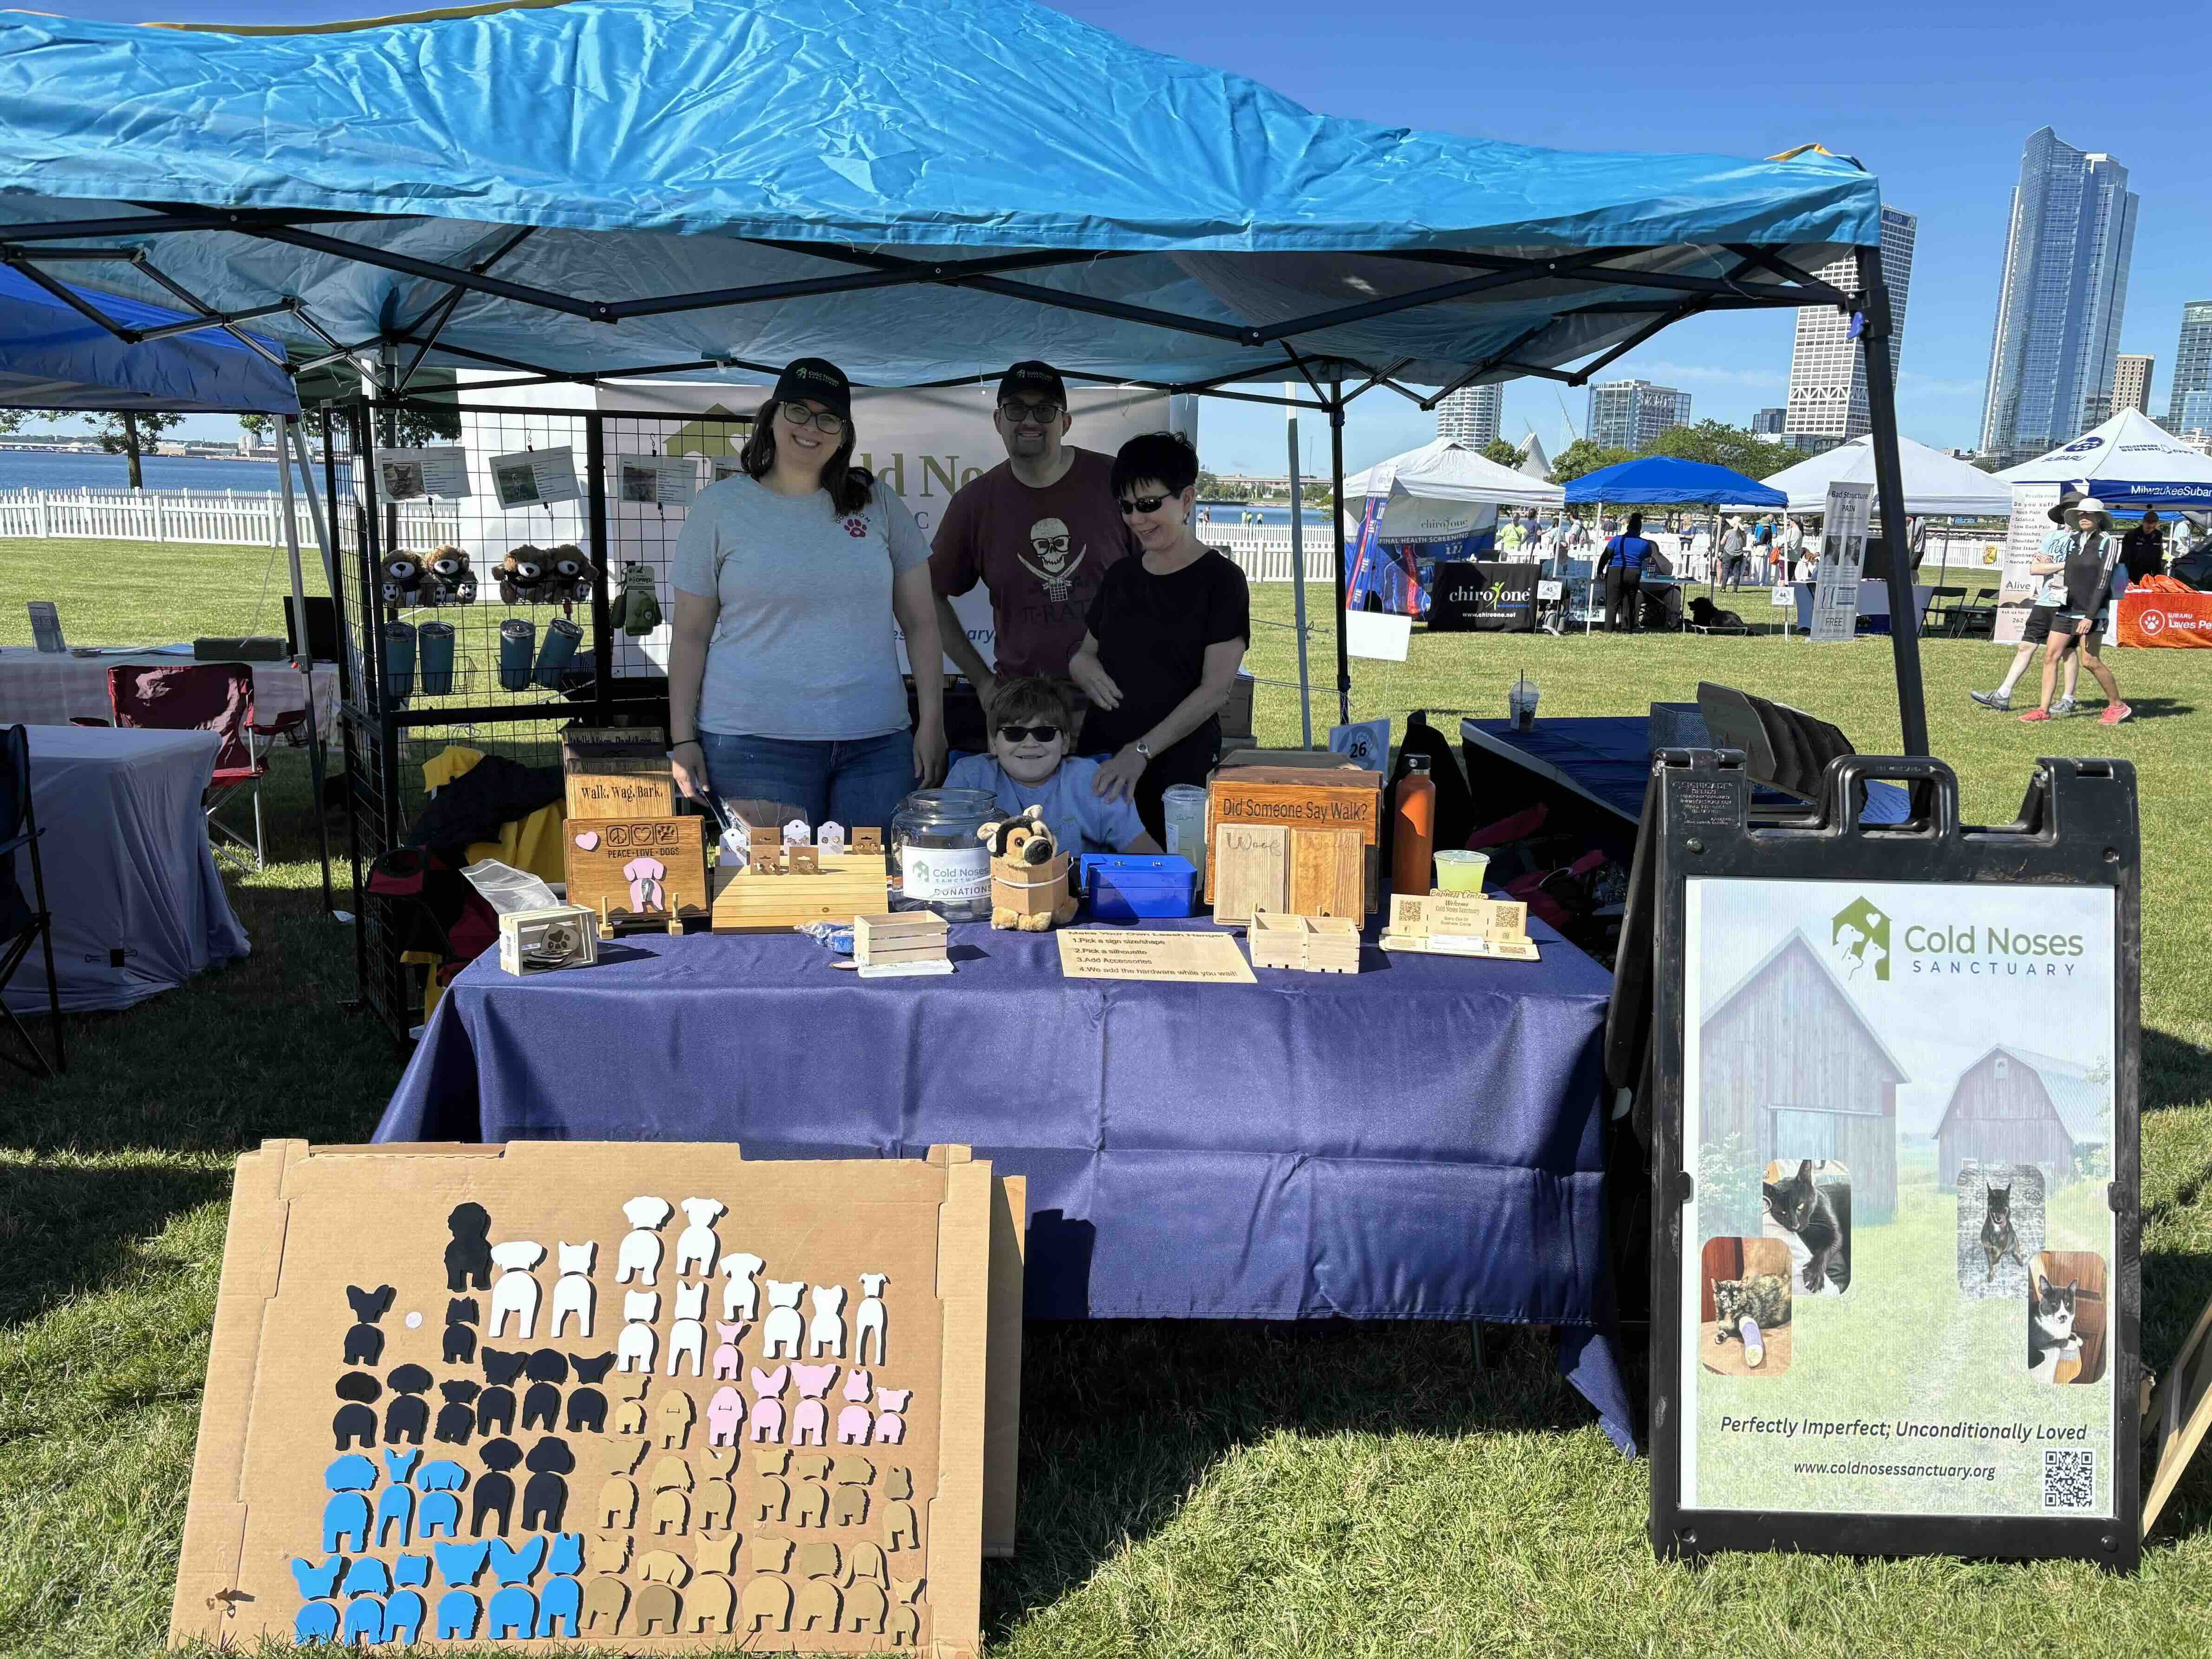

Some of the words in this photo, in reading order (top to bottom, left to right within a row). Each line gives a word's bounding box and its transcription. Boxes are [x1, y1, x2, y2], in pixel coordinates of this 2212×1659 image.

[1843, 491, 1869, 500] Structure
[2131, 485, 2212, 498] MilwaukeeSubar
[1429, 532, 1469, 543] SCREENING
[2006, 581, 2030, 589] Alive
[1449, 586, 1493, 602] chiro
[1501, 590, 1531, 602] one
[1825, 617, 1844, 626] FREE
[2169, 619, 2196, 629] Loves
[2199, 620, 2212, 629] Pe
[1350, 741, 1367, 758] 26
[581, 785, 609, 800] Walk.
[611, 785, 635, 802] Wag.
[637, 783, 663, 798] Bark.
[1223, 798, 1243, 816] Did
[1246, 799, 1302, 818] Someone
[1306, 801, 1328, 823] Say
[1330, 802, 1368, 821] Walk?
[608, 849, 632, 859] PEACE
[636, 847, 655, 857] LOVE
[660, 847, 680, 856] DOGS
[933, 868, 956, 877] Cold
[960, 867, 989, 877] Noses
[1905, 925, 1975, 954] Cold
[1987, 927, 2084, 956] Noses
[1912, 960, 2075, 976] SANCTUARY
[1720, 1416, 1798, 1438] Perfectly
[1803, 1418, 1891, 1440] Imperfect;
[1896, 1421, 2033, 1443] Unconditionally
[2036, 1424, 2087, 1440] Loved
[1794, 1461, 1996, 1481] www.coldnosessanctuary.org
